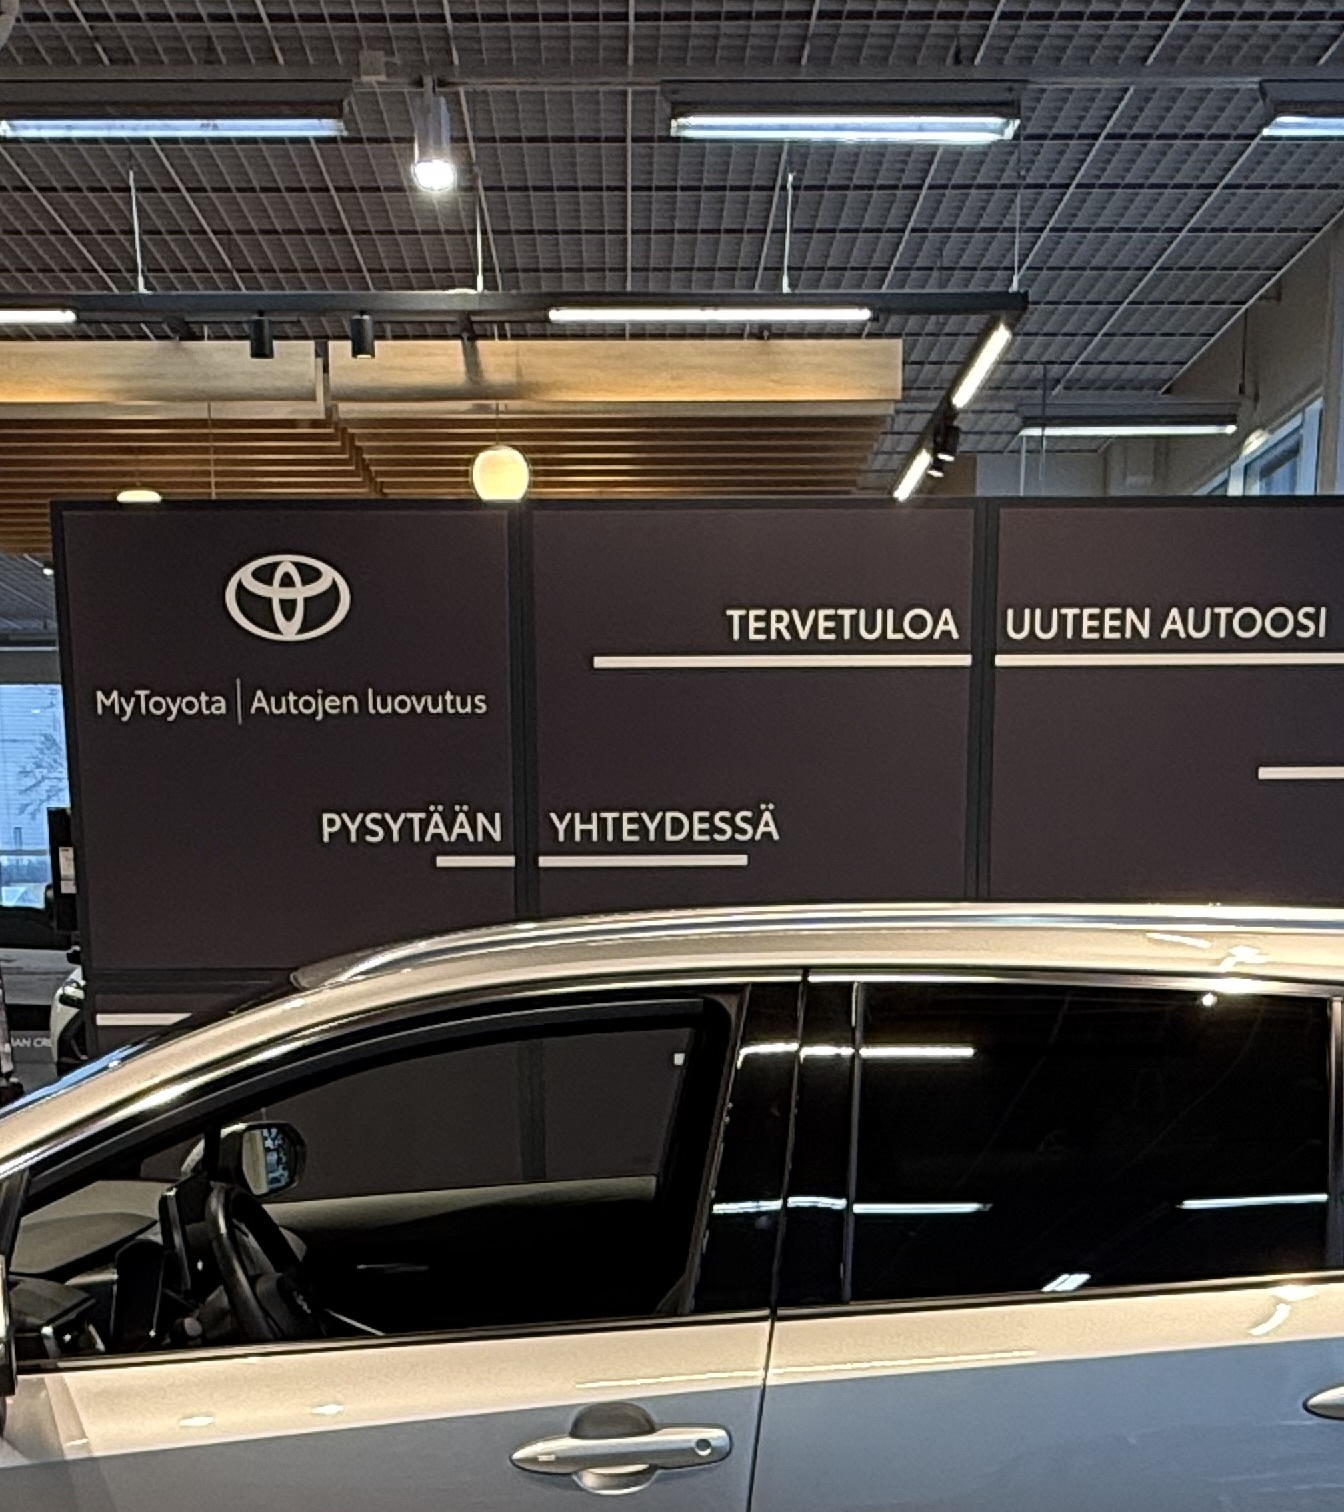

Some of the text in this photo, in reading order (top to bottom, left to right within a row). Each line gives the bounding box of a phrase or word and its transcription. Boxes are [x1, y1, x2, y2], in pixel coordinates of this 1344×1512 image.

[724, 605, 1328, 642] TERVETULOA UUTEEN AUTOOSI
[95, 687, 488, 723] MyToyota Autojen luovutus
[321, 802, 781, 844] PYSYTÄÄN YHTEYDESSÄ
